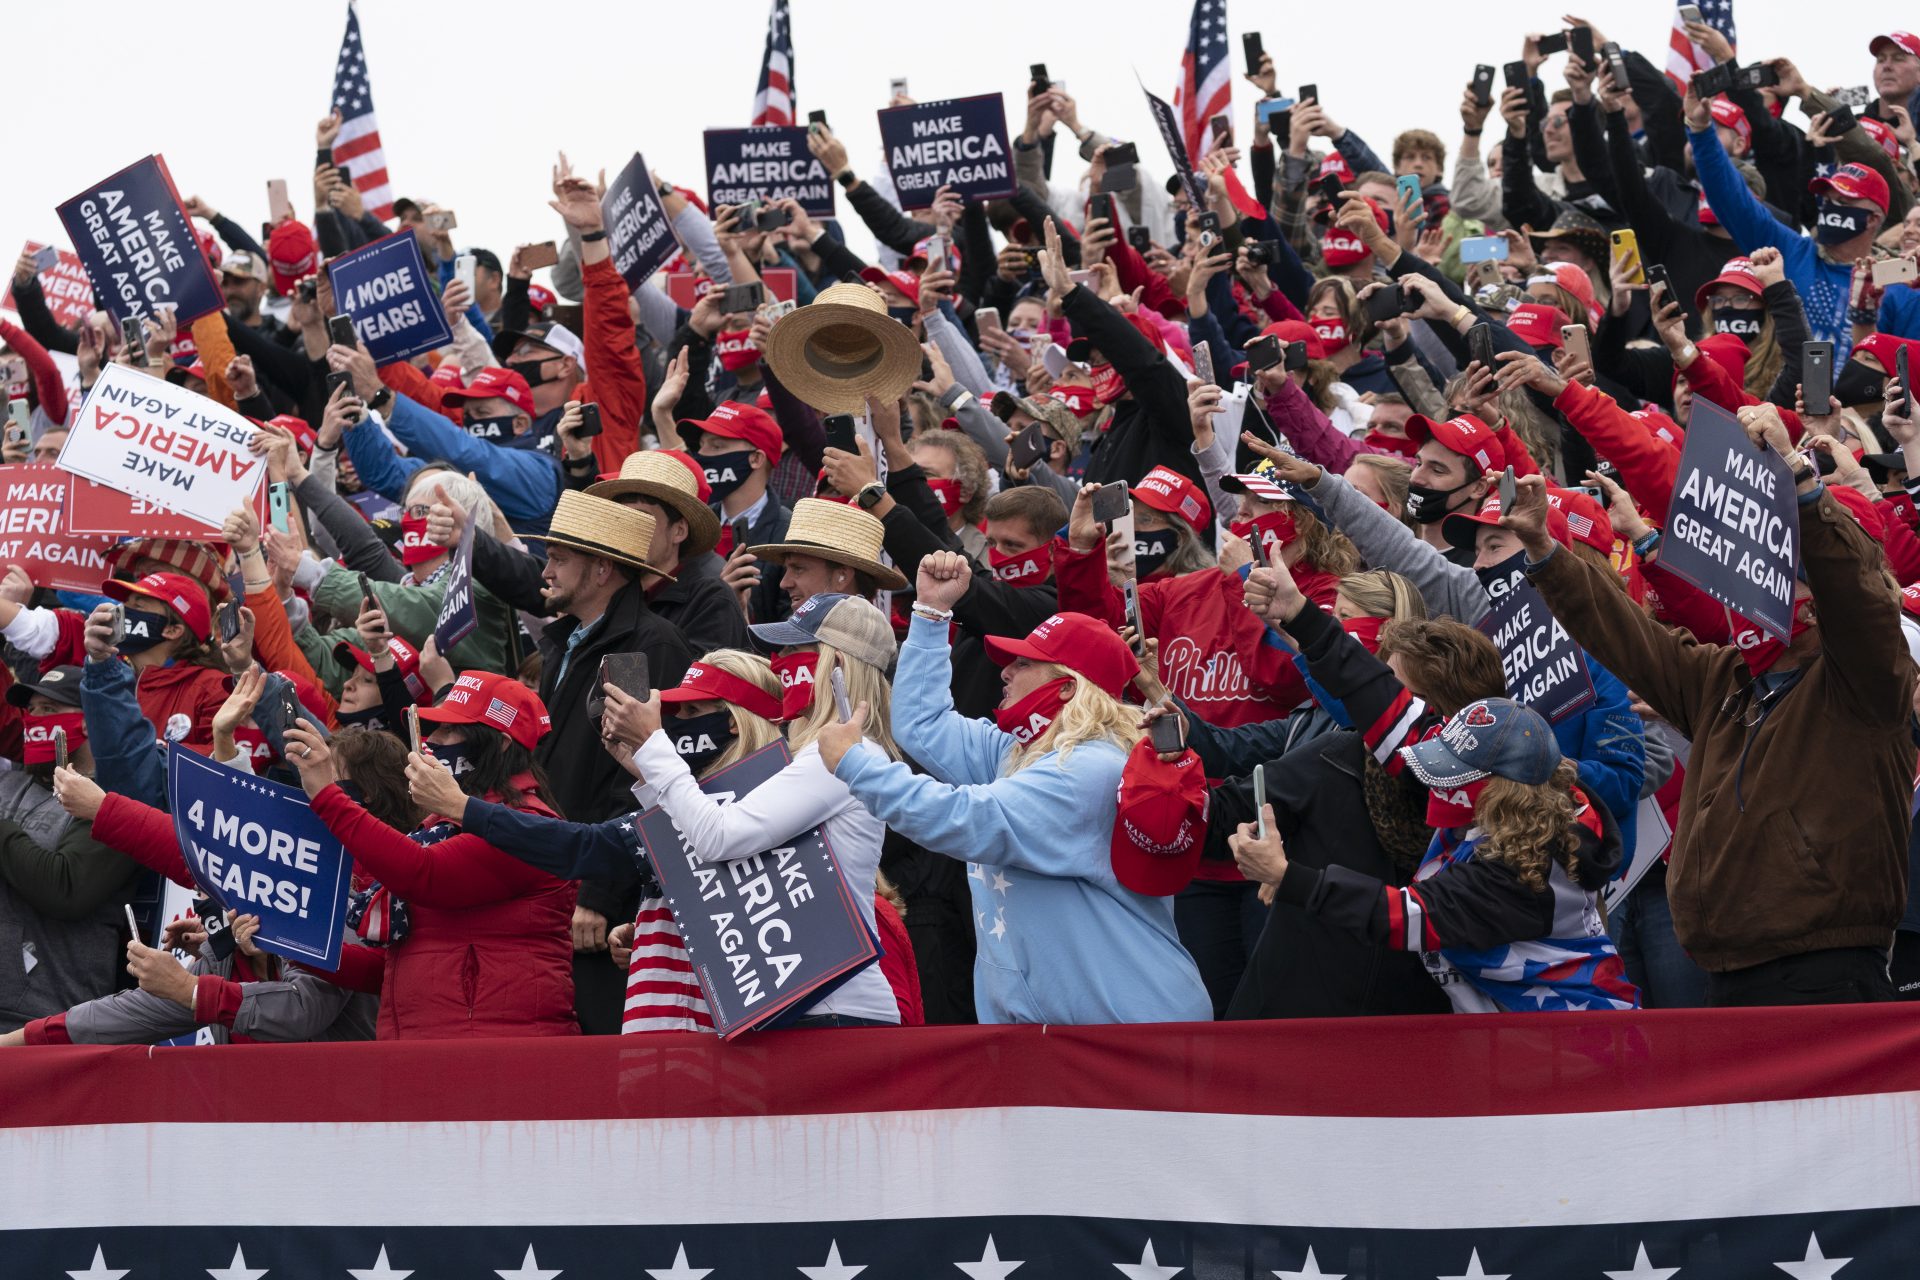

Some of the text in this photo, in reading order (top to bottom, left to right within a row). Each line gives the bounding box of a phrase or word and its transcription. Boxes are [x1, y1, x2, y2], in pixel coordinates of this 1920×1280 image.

[913, 116, 963, 138] MAKE
[741, 142, 791, 158] MAKE
[892, 134, 1004, 170] AMERICA
[712, 160, 826, 184] AMERICA
[897, 161, 1007, 192] GREAT AGAIN
[712, 185, 829, 204] GREAT AGAIN
[80, 200, 122, 265] GREAT
[98, 190, 179, 314] AMERICA
[144, 210, 185, 272] MAKE
[637, 218, 668, 256] AGAIN
[345, 266, 415, 312] 4 MORE
[352, 299, 426, 344] YEARS!
[101, 383, 181, 420] AGAIN
[95, 405, 256, 483] AMERICA
[464, 423, 501, 437] GA
[7, 483, 65, 503] MAKE
[122, 451, 195, 492] MAKE
[1724, 448, 1776, 501] MAKE
[1679, 467, 1793, 569] AMERICA
[25, 540, 106, 570] AGAIN
[1673, 513, 1735, 567] GREAT
[1735, 550, 1791, 607] AGAIN
[1485, 570, 1525, 601] GA
[1493, 603, 1532, 650] MAKE
[1502, 616, 1570, 690] ERICA
[1523, 651, 1579, 706] AGAIN
[676, 734, 718, 754] GA
[1012, 712, 1052, 744] GA
[187, 800, 321, 875] 4 MORE
[1124, 818, 1153, 846] MAKE
[191, 840, 312, 919] YEARS!
[771, 847, 815, 909] AKE
[671, 820, 726, 902] REAT
[709, 911, 766, 1008] AGAIN
